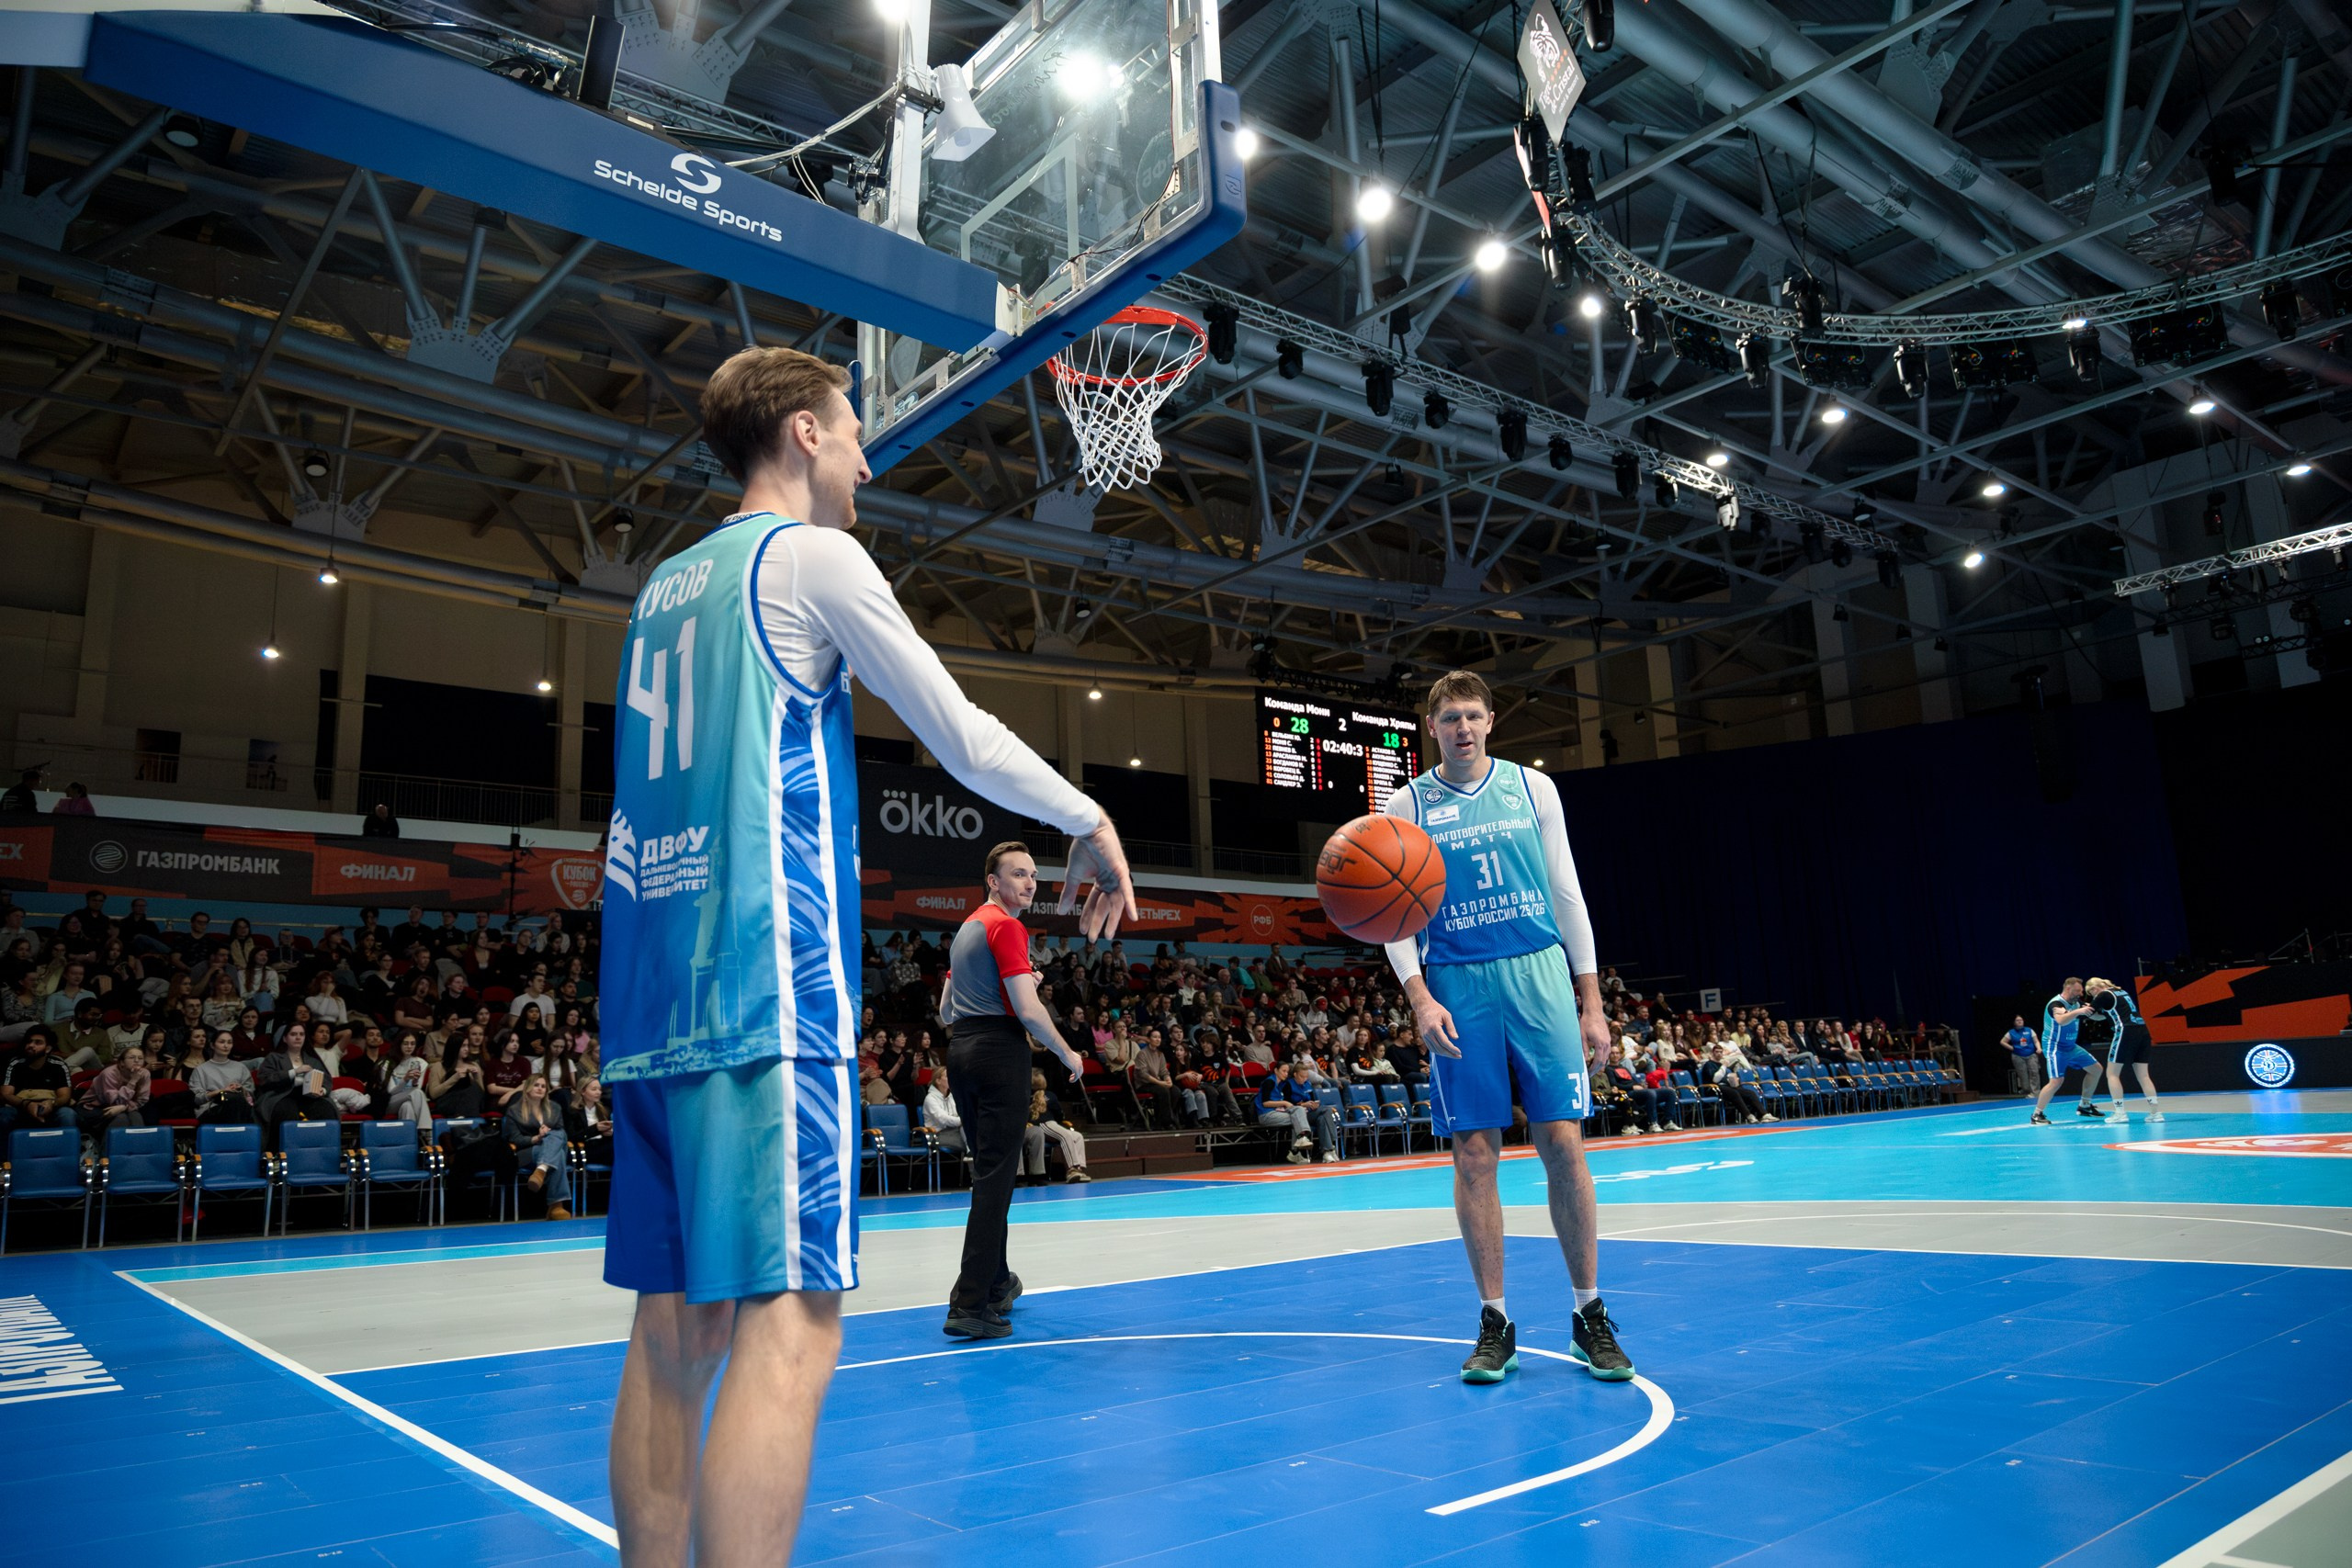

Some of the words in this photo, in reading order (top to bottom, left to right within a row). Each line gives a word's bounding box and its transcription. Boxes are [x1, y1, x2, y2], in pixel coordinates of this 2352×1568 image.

[594, 159, 698, 211] Schelde
[703, 199, 783, 243] Sports
[627, 616, 696, 781] 41
[1264, 696, 1306, 714] Команда
[1290, 716, 1309, 735] 28
[1338, 717, 1348, 732] 2
[1351, 711, 1389, 728] Команда
[1322, 739, 1363, 757] 02:40:3
[1383, 731, 1400, 749] 18
[1402, 737, 1408, 748] 3
[879, 789, 984, 840] ökko
[1429, 817, 1532, 844] ЛАГОТВОРИТЕЛЬНЫЙ
[640, 826, 709, 867] ДВФУ
[1451, 830, 1512, 852] МАТЧ
[136, 851, 280, 875] ГАЗПРОМБАНК
[1471, 850, 1504, 890] 31
[340, 864, 416, 883] ФИНАЛ
[562, 864, 597, 884] КУБОК
[916, 897, 966, 910] ФИНАЛ
[1253, 915, 1272, 926] РФБ
[1445, 914, 1477, 932] КУБОК
[1477, 910, 1519, 927] РОССИИ
[1519, 902, 1545, 918] 25/26
[1704, 993, 1716, 1009] F
